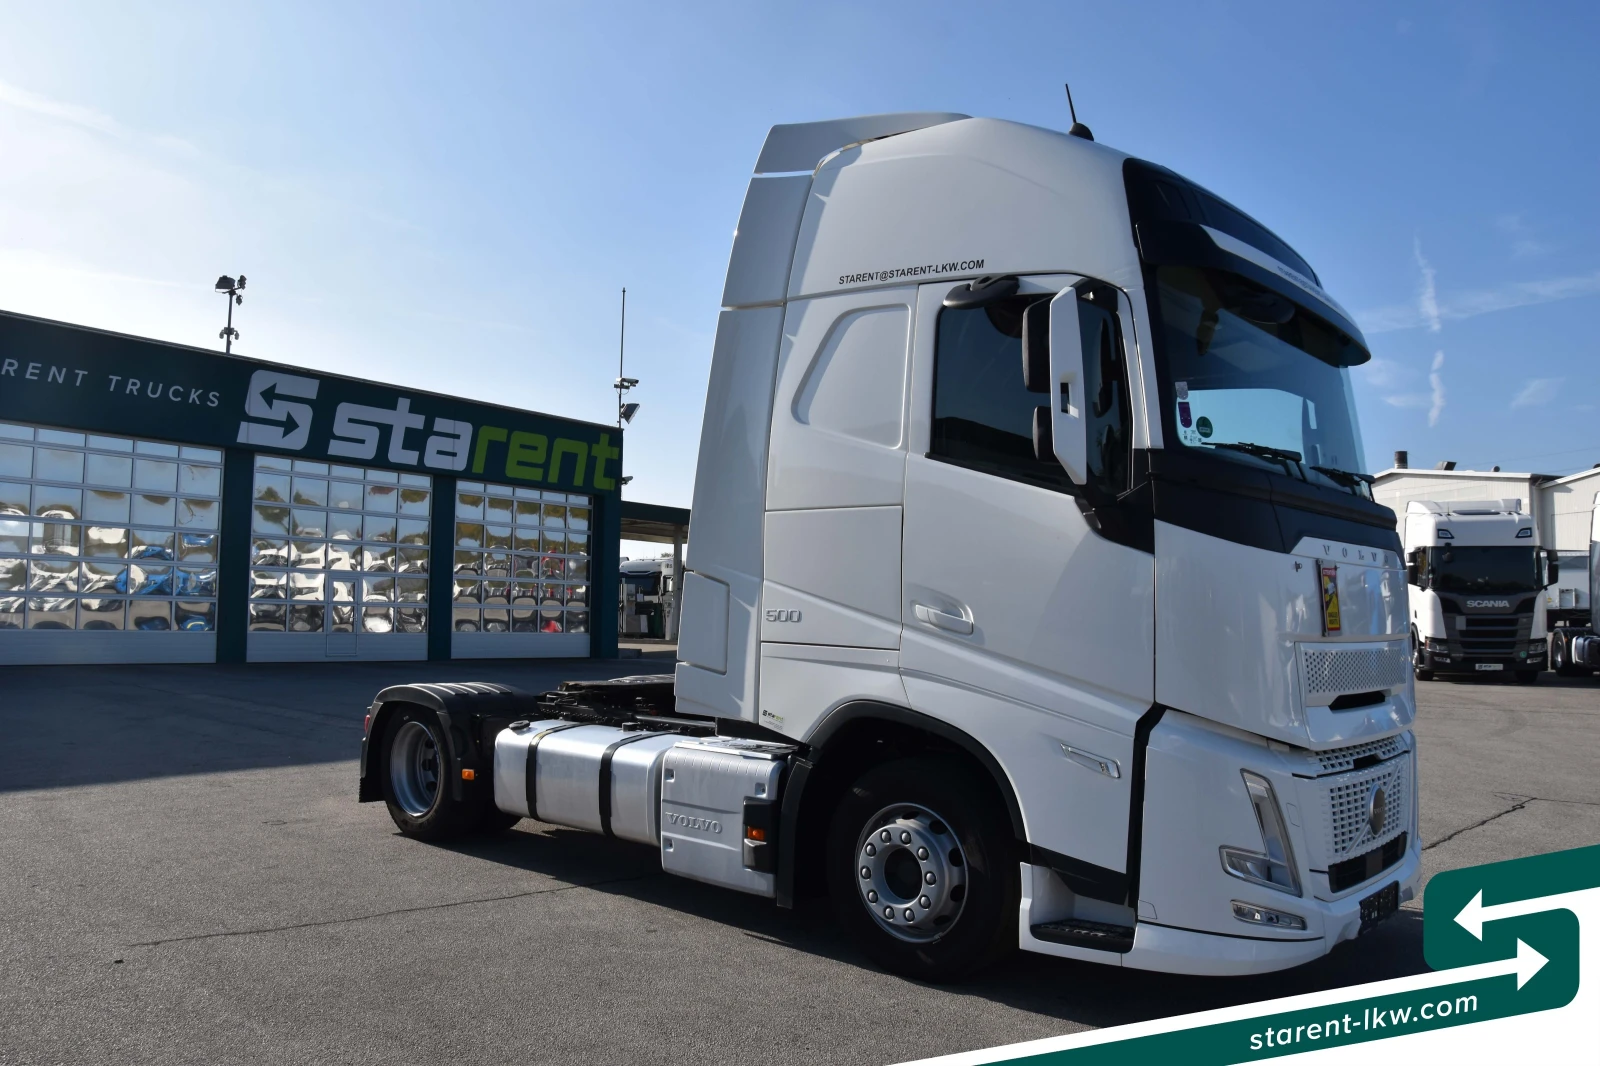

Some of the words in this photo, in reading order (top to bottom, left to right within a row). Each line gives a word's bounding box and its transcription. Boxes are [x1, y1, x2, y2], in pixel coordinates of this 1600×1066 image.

[839, 259, 985, 285] STARENT@STARENT-LKW.COM
[1, 358, 88, 386] RENT
[108, 375, 220, 407] TRUCKS
[327, 397, 620, 491] starent
[1323, 544, 1389, 564] VOLVO
[765, 608, 803, 623] 500
[1466, 600, 1510, 608] SCANIA
[665, 811, 723, 834] VOLVO
